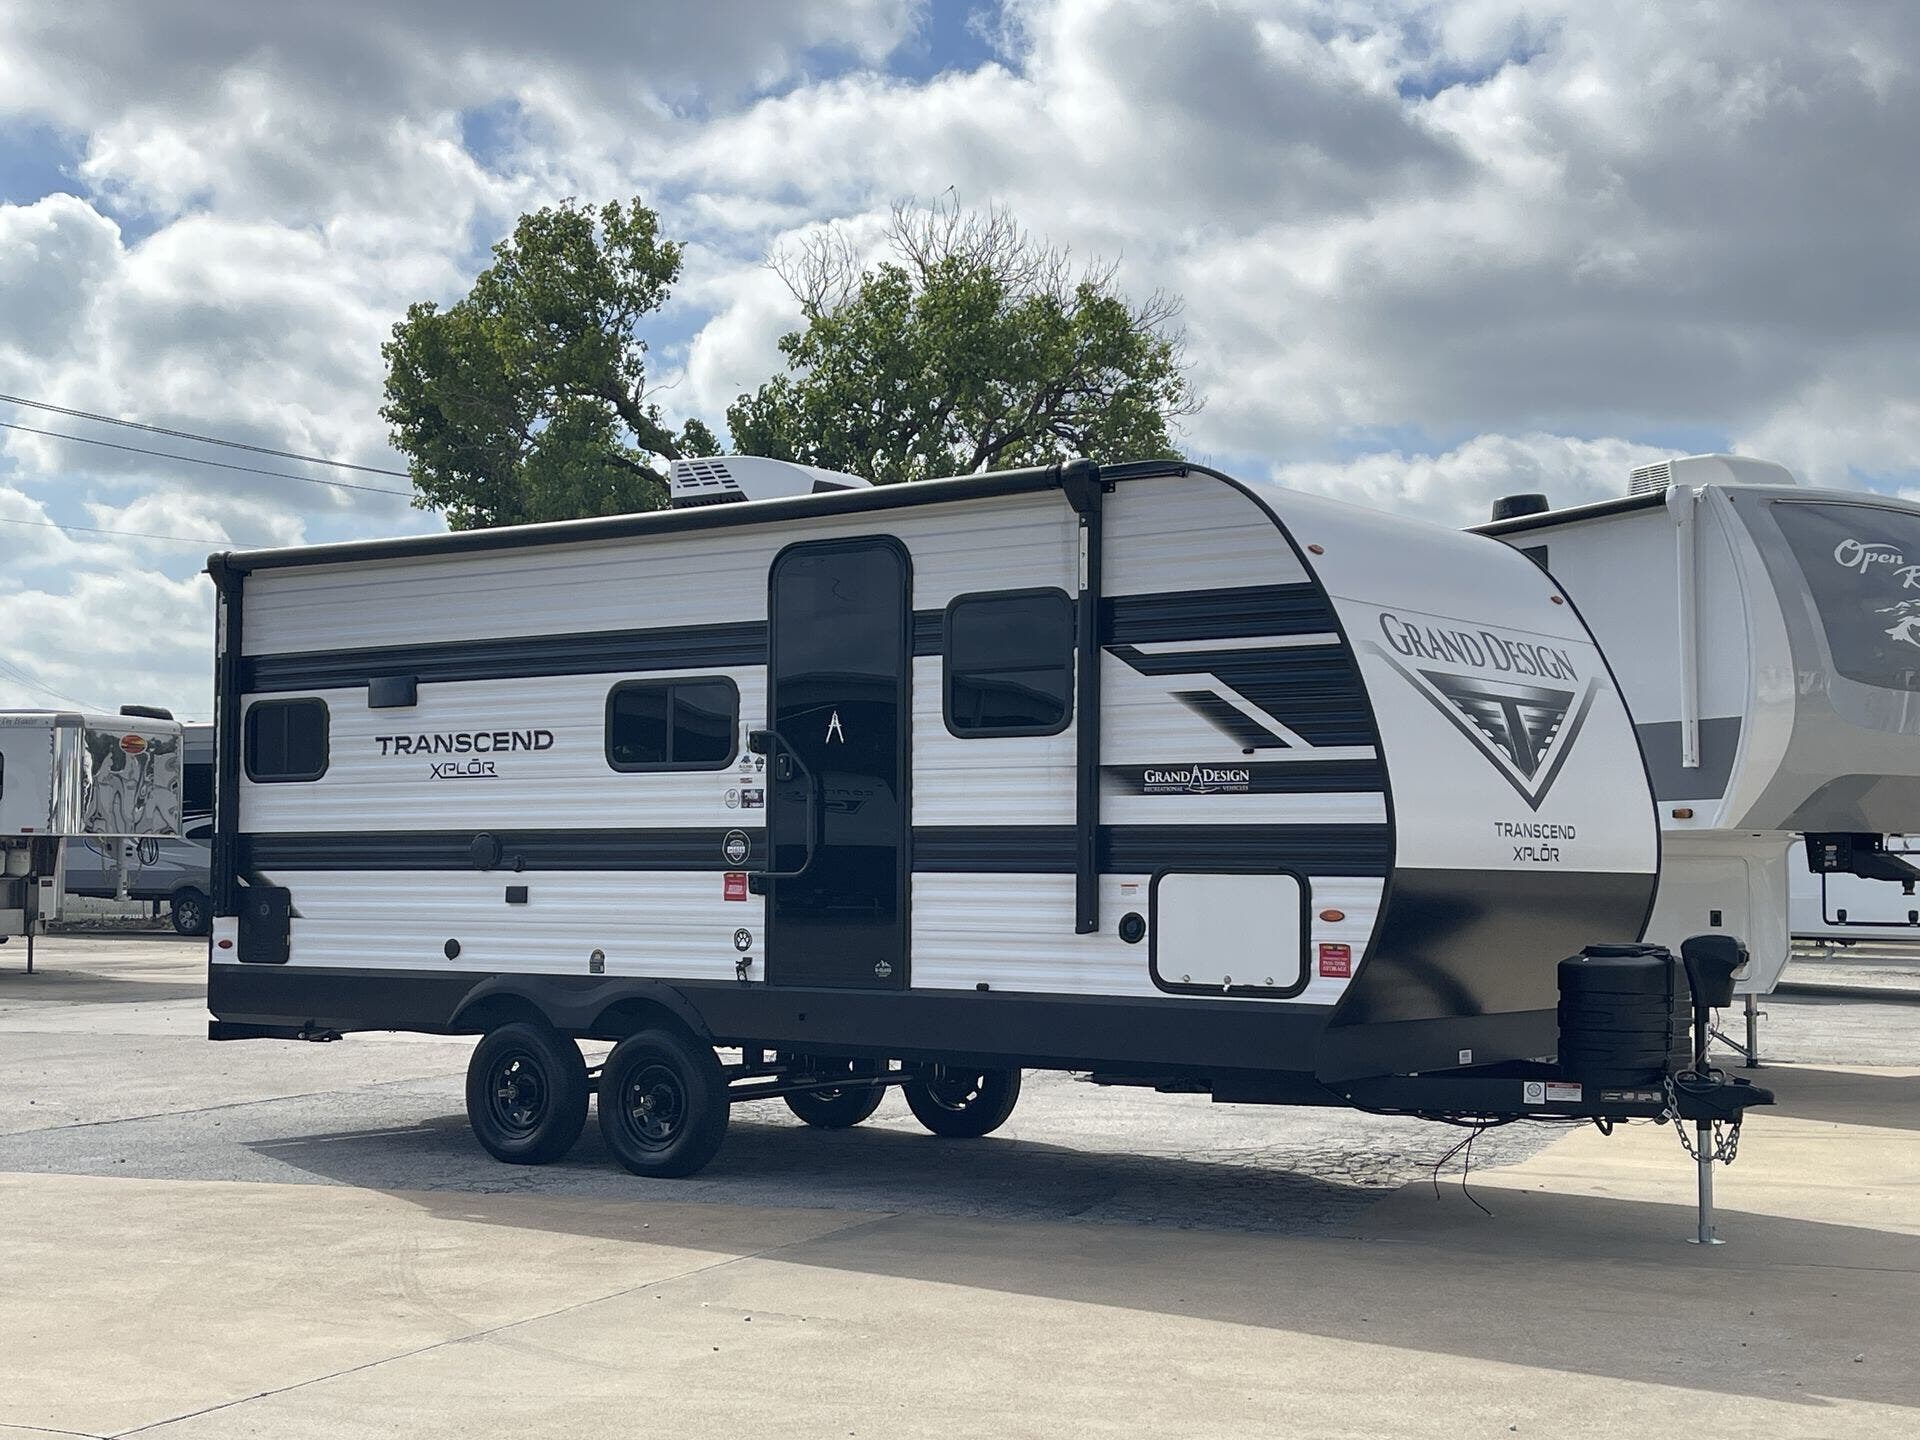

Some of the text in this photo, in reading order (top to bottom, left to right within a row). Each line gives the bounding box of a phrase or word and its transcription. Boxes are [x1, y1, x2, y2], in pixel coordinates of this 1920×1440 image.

[1834, 538, 1904, 574] Open
[1893, 565, 1920, 588] R
[1379, 612, 1579, 682] GRAND DESIGN
[375, 729, 554, 756] TRANSCEND
[1144, 768, 1249, 783] GRAND DESIGN
[1494, 822, 1576, 840] TRANSCEND
